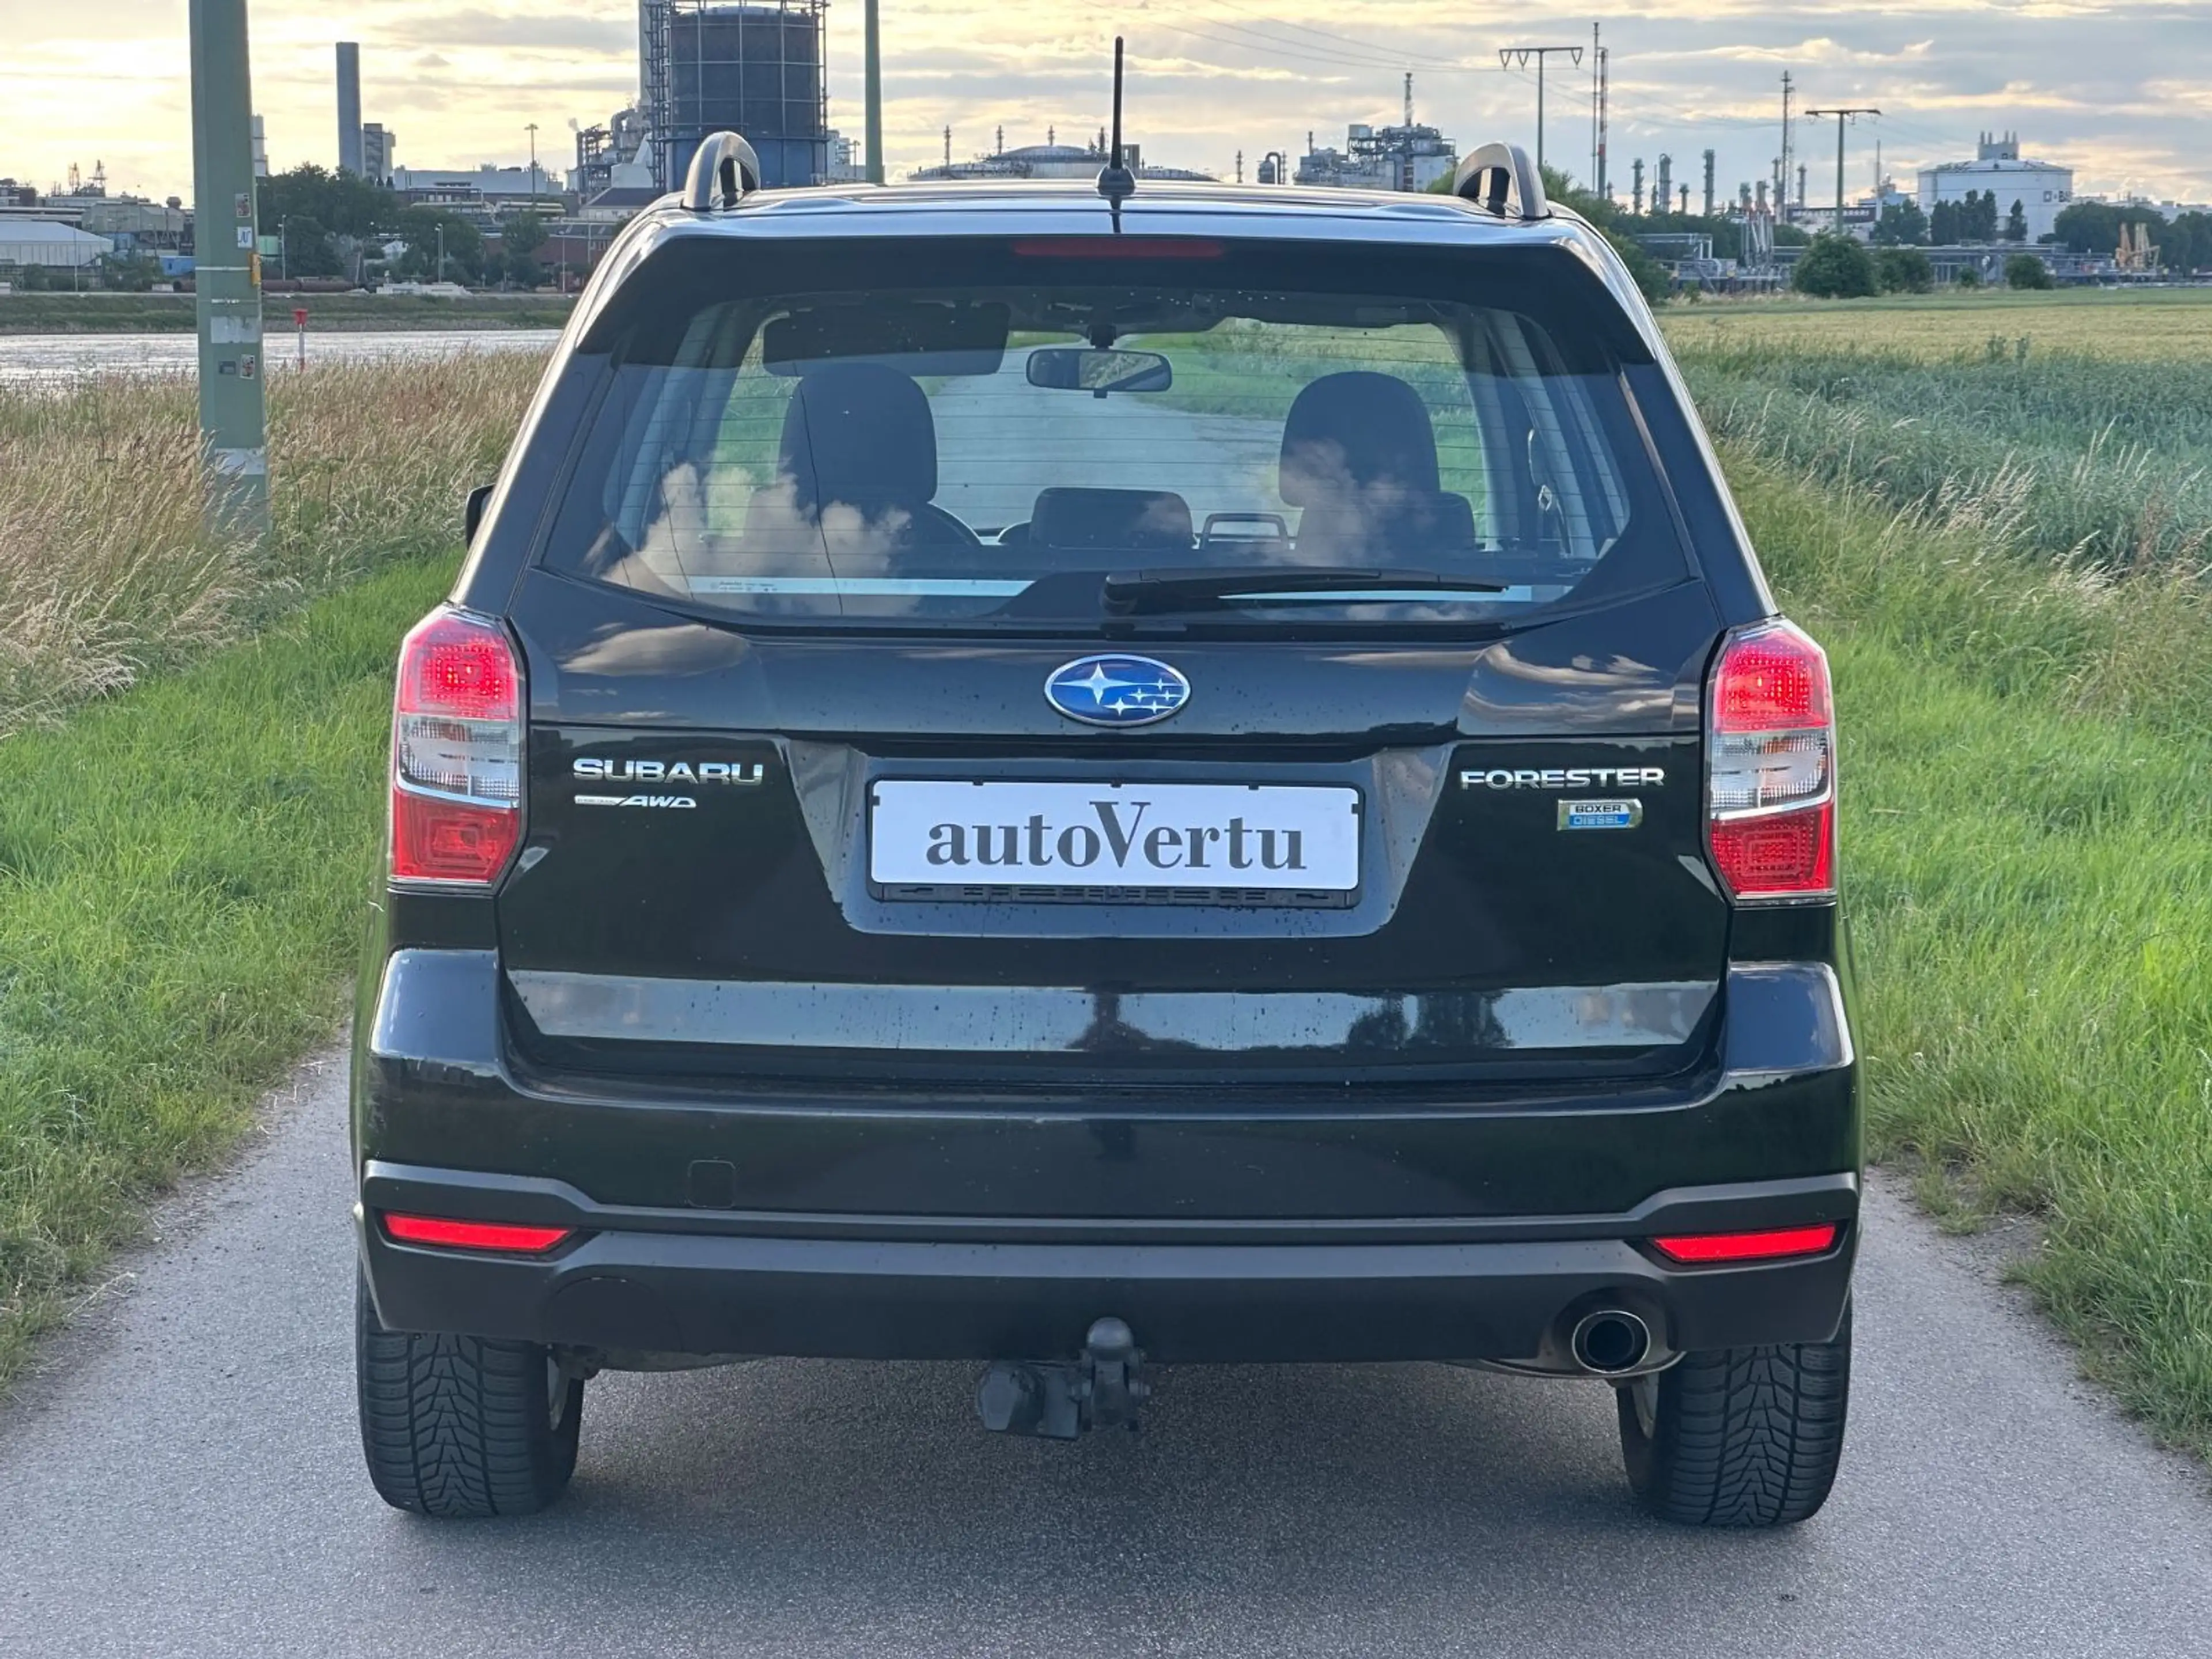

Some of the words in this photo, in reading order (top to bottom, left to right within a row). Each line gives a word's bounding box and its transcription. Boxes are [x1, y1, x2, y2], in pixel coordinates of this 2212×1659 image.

[573, 758, 763, 786] SUBARU
[1460, 767, 1665, 790] FORESTER
[620, 795, 697, 808] AWD
[1575, 804, 1622, 813] BOXER
[1573, 815, 1624, 825] DIESEL
[926, 801, 1308, 870] autoVertu
